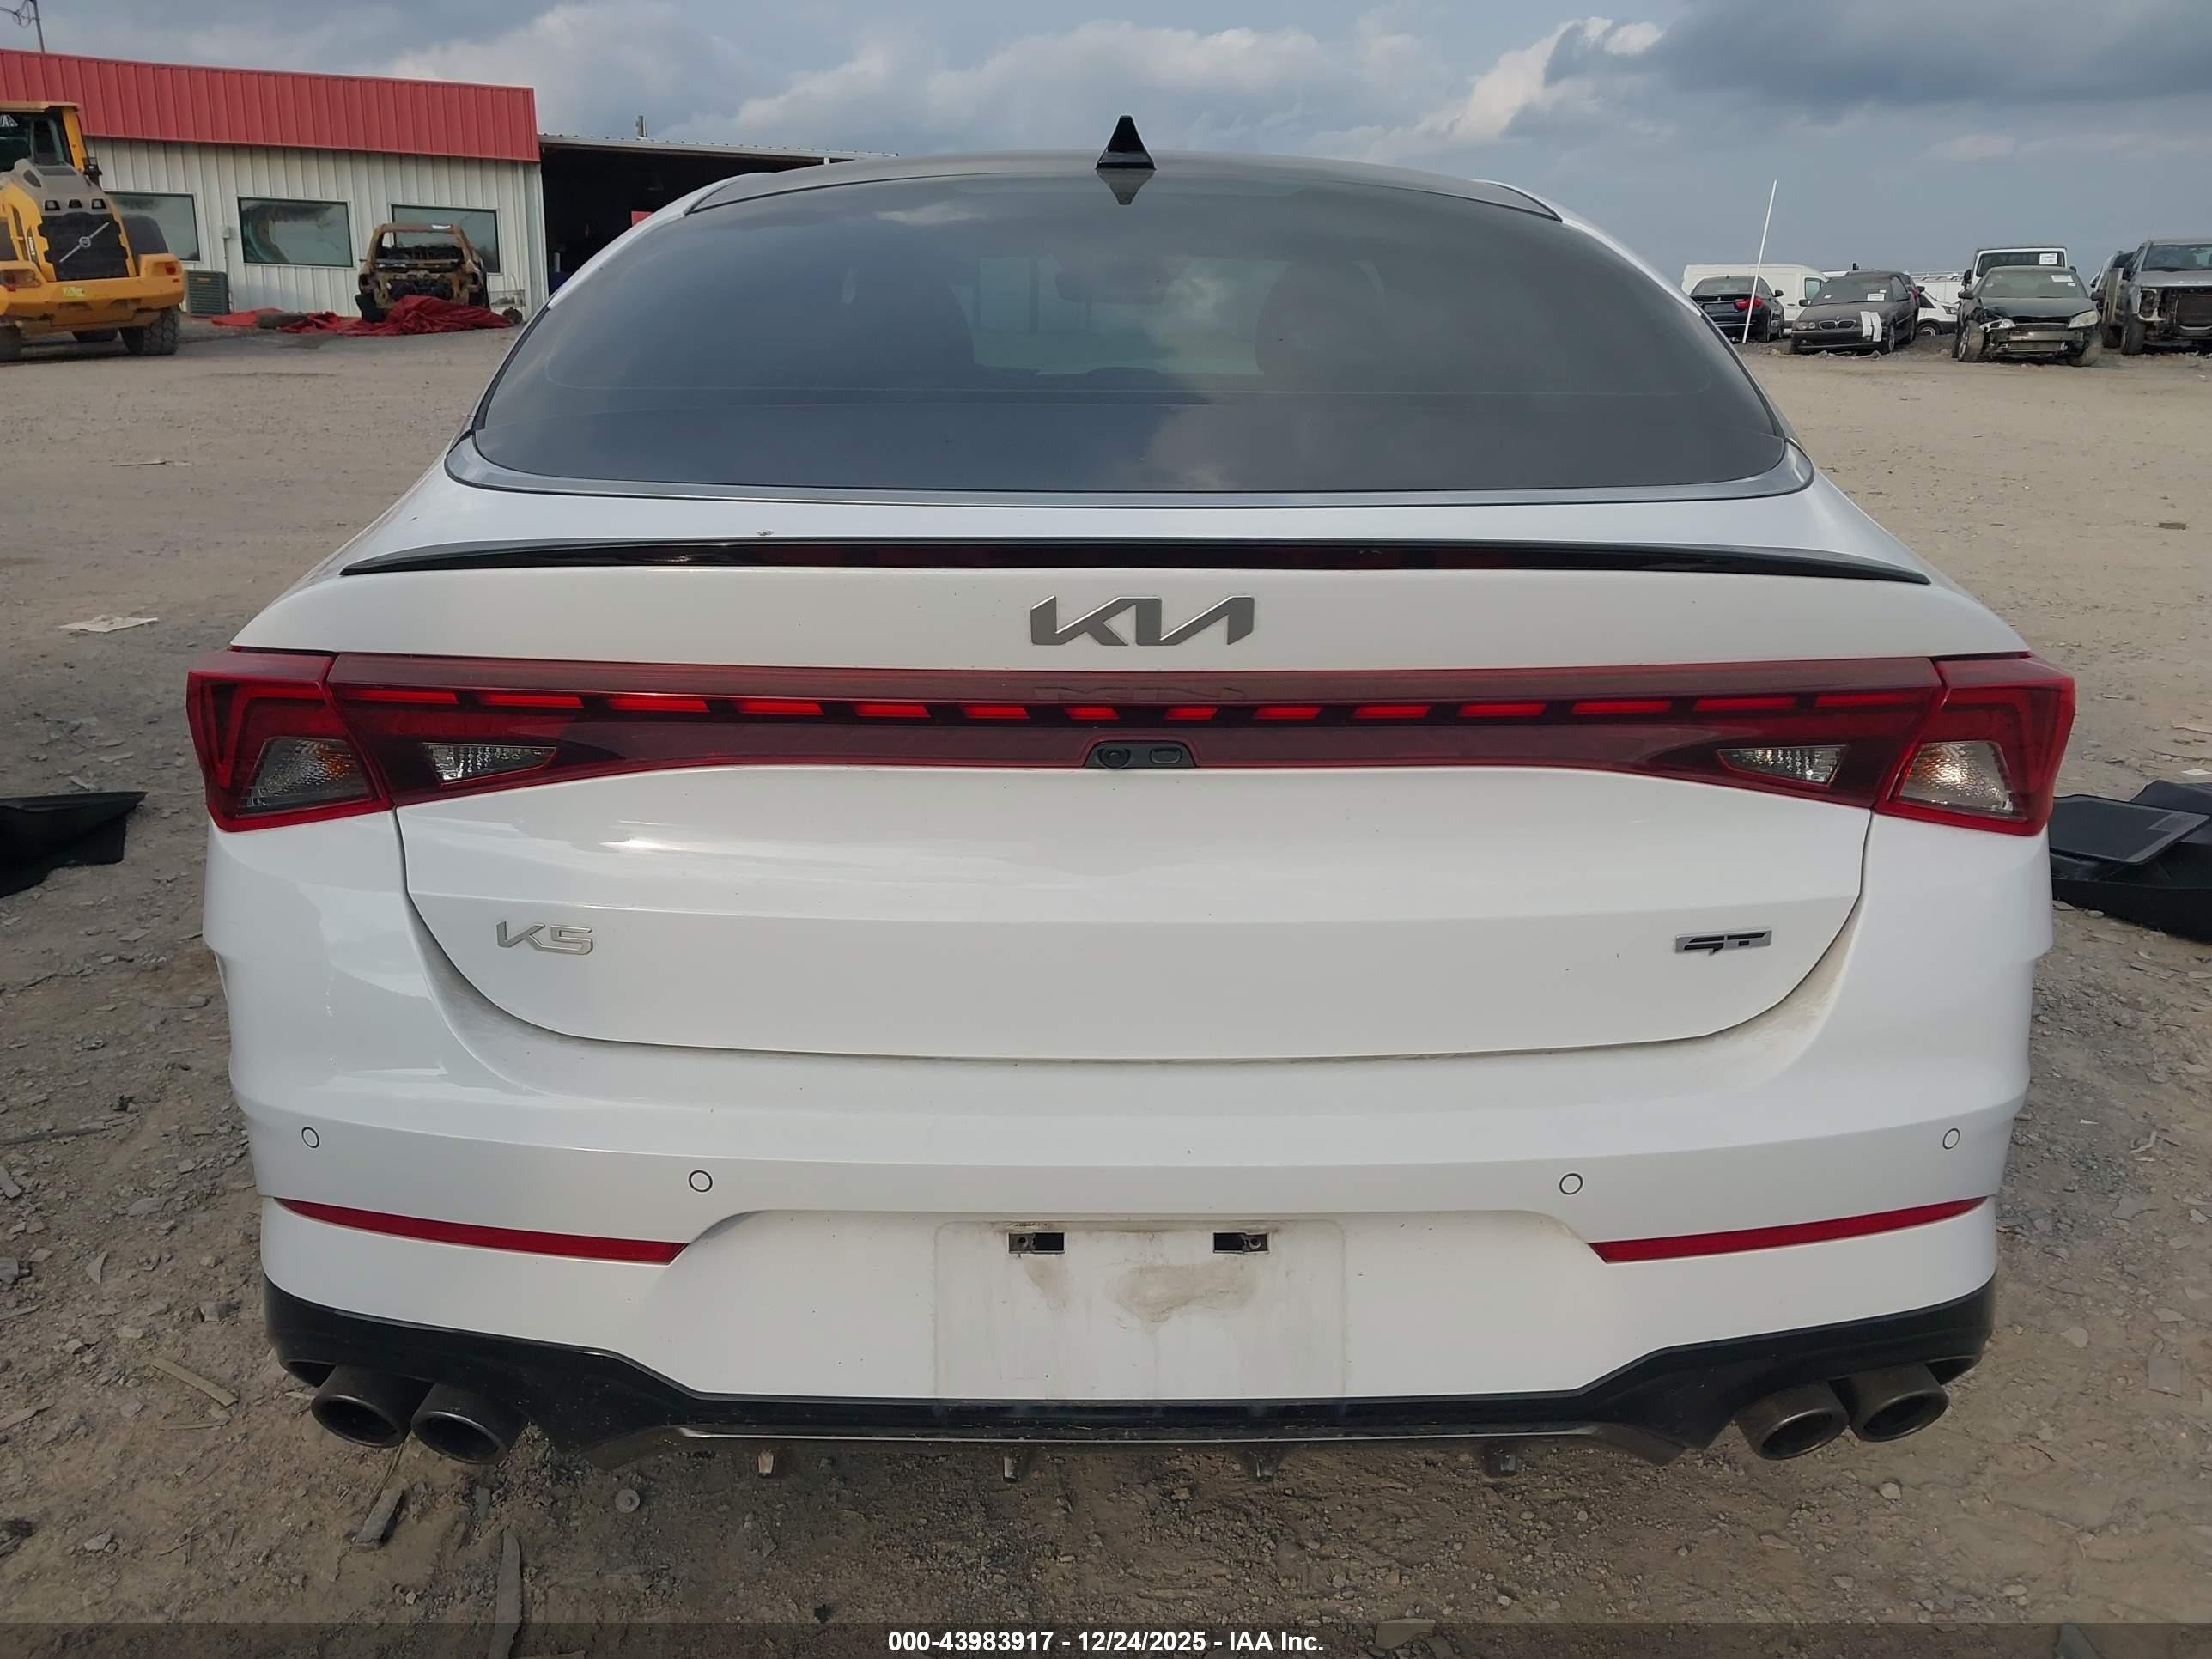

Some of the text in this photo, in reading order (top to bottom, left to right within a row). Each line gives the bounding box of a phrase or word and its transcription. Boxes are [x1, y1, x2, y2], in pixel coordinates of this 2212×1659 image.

[1030, 595, 1255, 646] KIA
[496, 920, 594, 955] K5
[1675, 927, 1772, 956] GT
